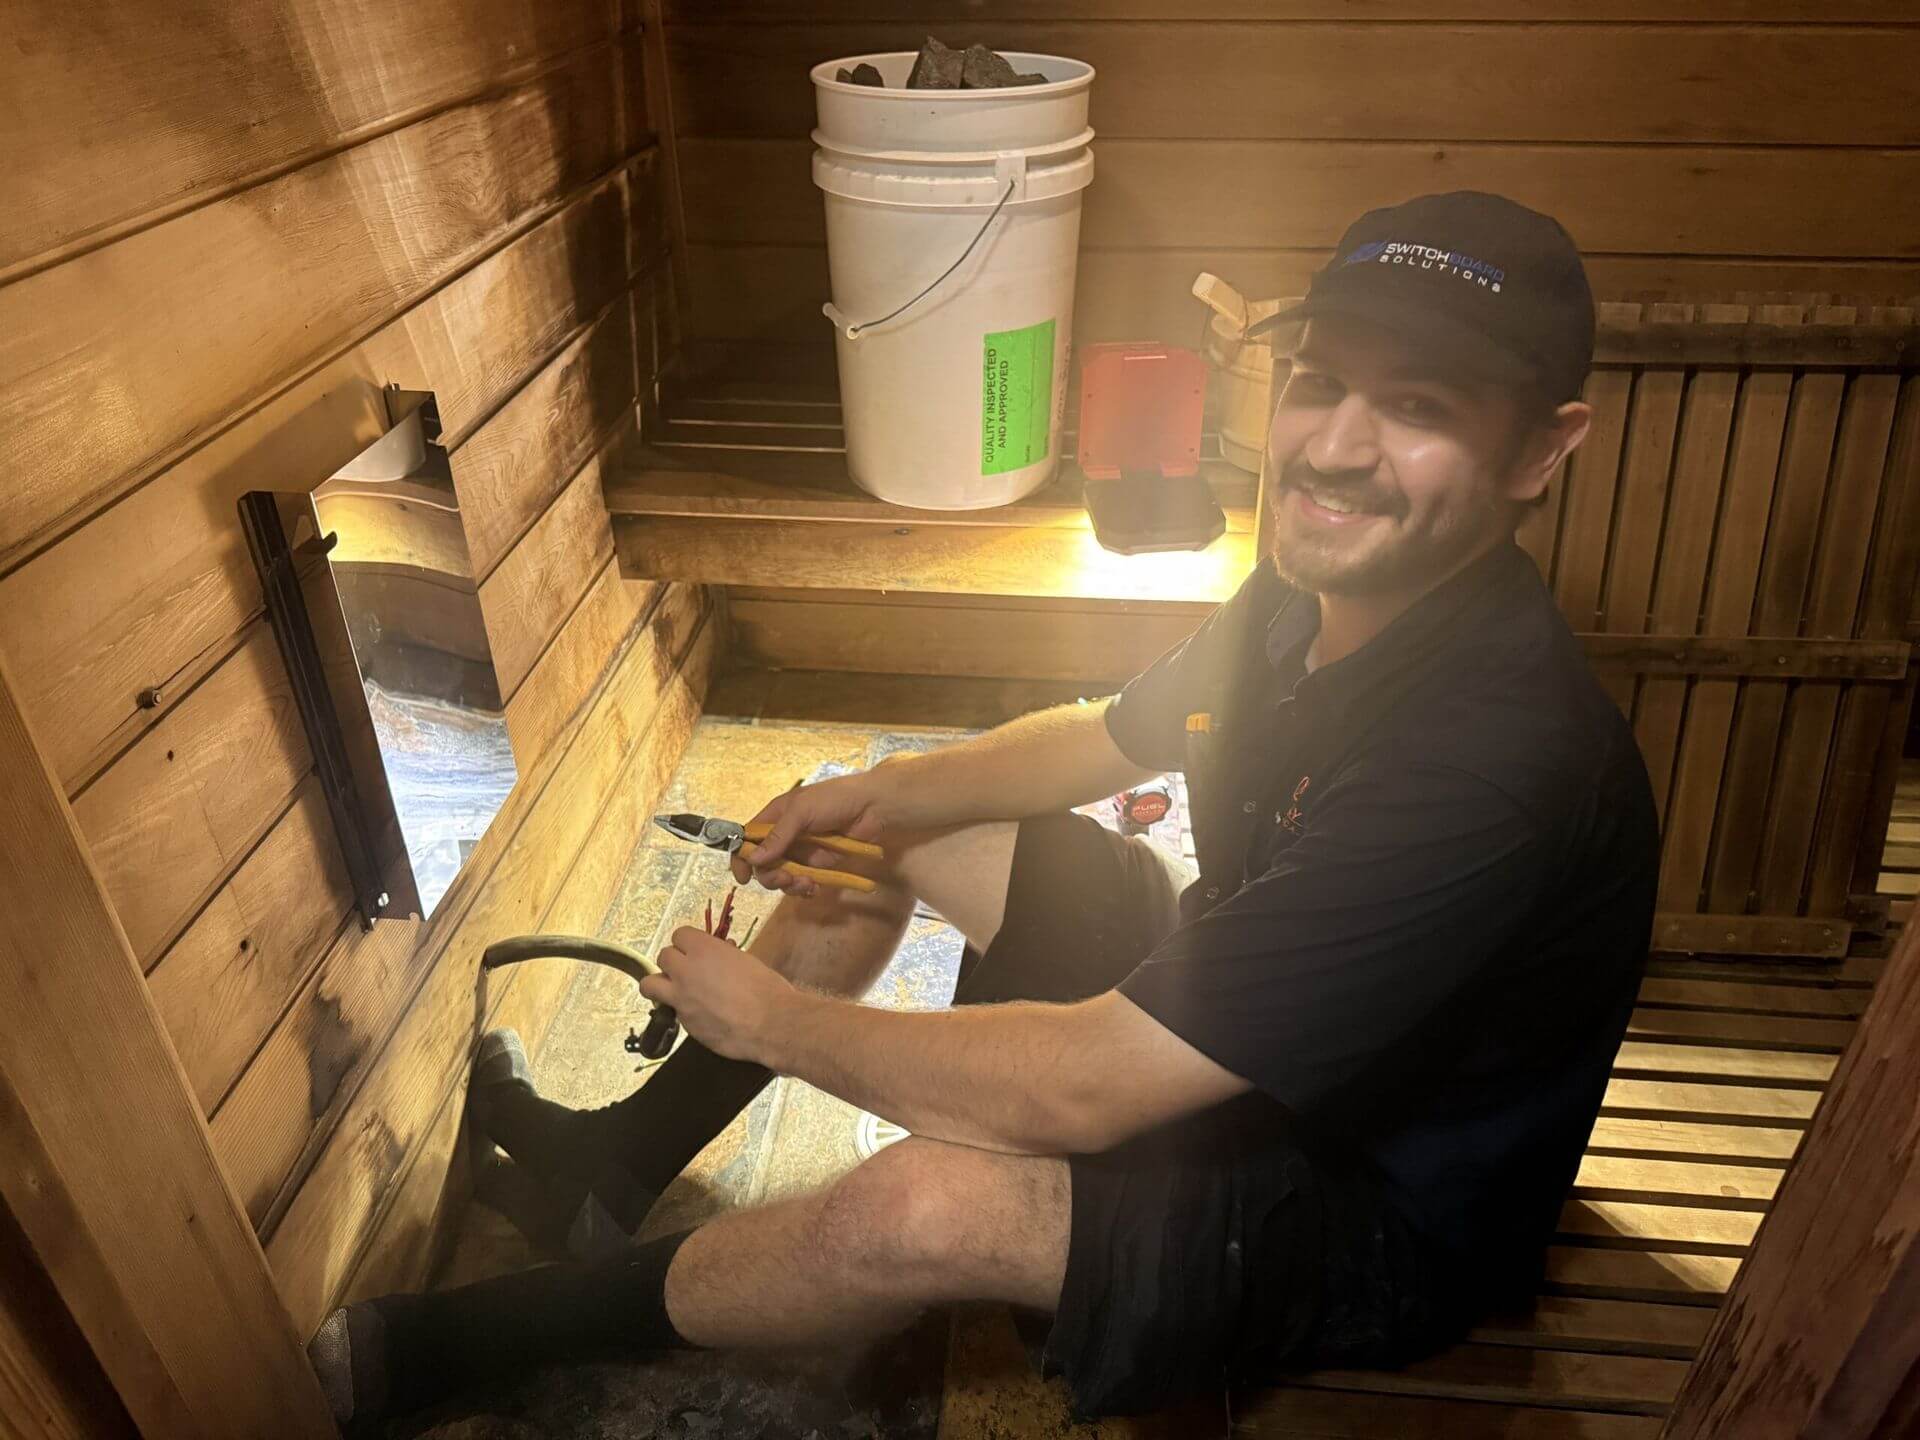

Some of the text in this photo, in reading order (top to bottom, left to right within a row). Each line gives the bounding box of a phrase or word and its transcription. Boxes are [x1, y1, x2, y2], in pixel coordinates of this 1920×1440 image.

[1379, 254, 1501, 293] SOLUTIONS
[1384, 243, 1505, 282] SWITCHBOARD
[985, 348, 997, 463] QUALITY INSPECTED
[998, 360, 1009, 449] AND APPROVED
